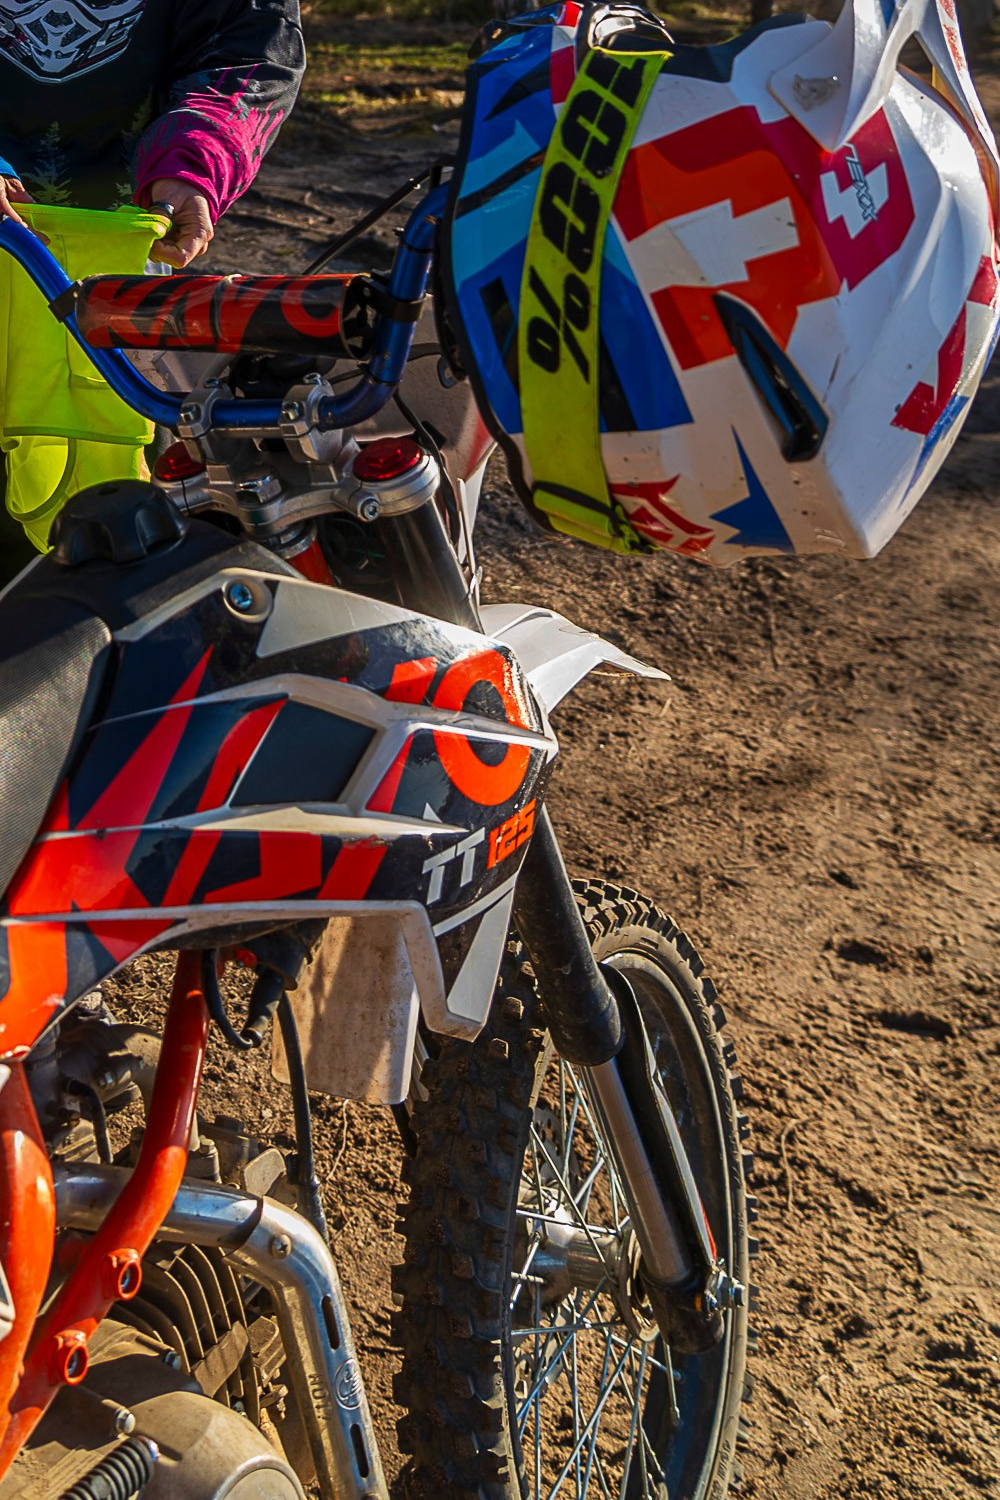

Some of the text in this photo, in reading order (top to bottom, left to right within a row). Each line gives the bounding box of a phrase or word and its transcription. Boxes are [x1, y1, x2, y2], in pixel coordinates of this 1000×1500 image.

[526, 51, 647, 386] 100%
[85, 275, 343, 354] KAYO
[421, 797, 538, 905] TT 125
